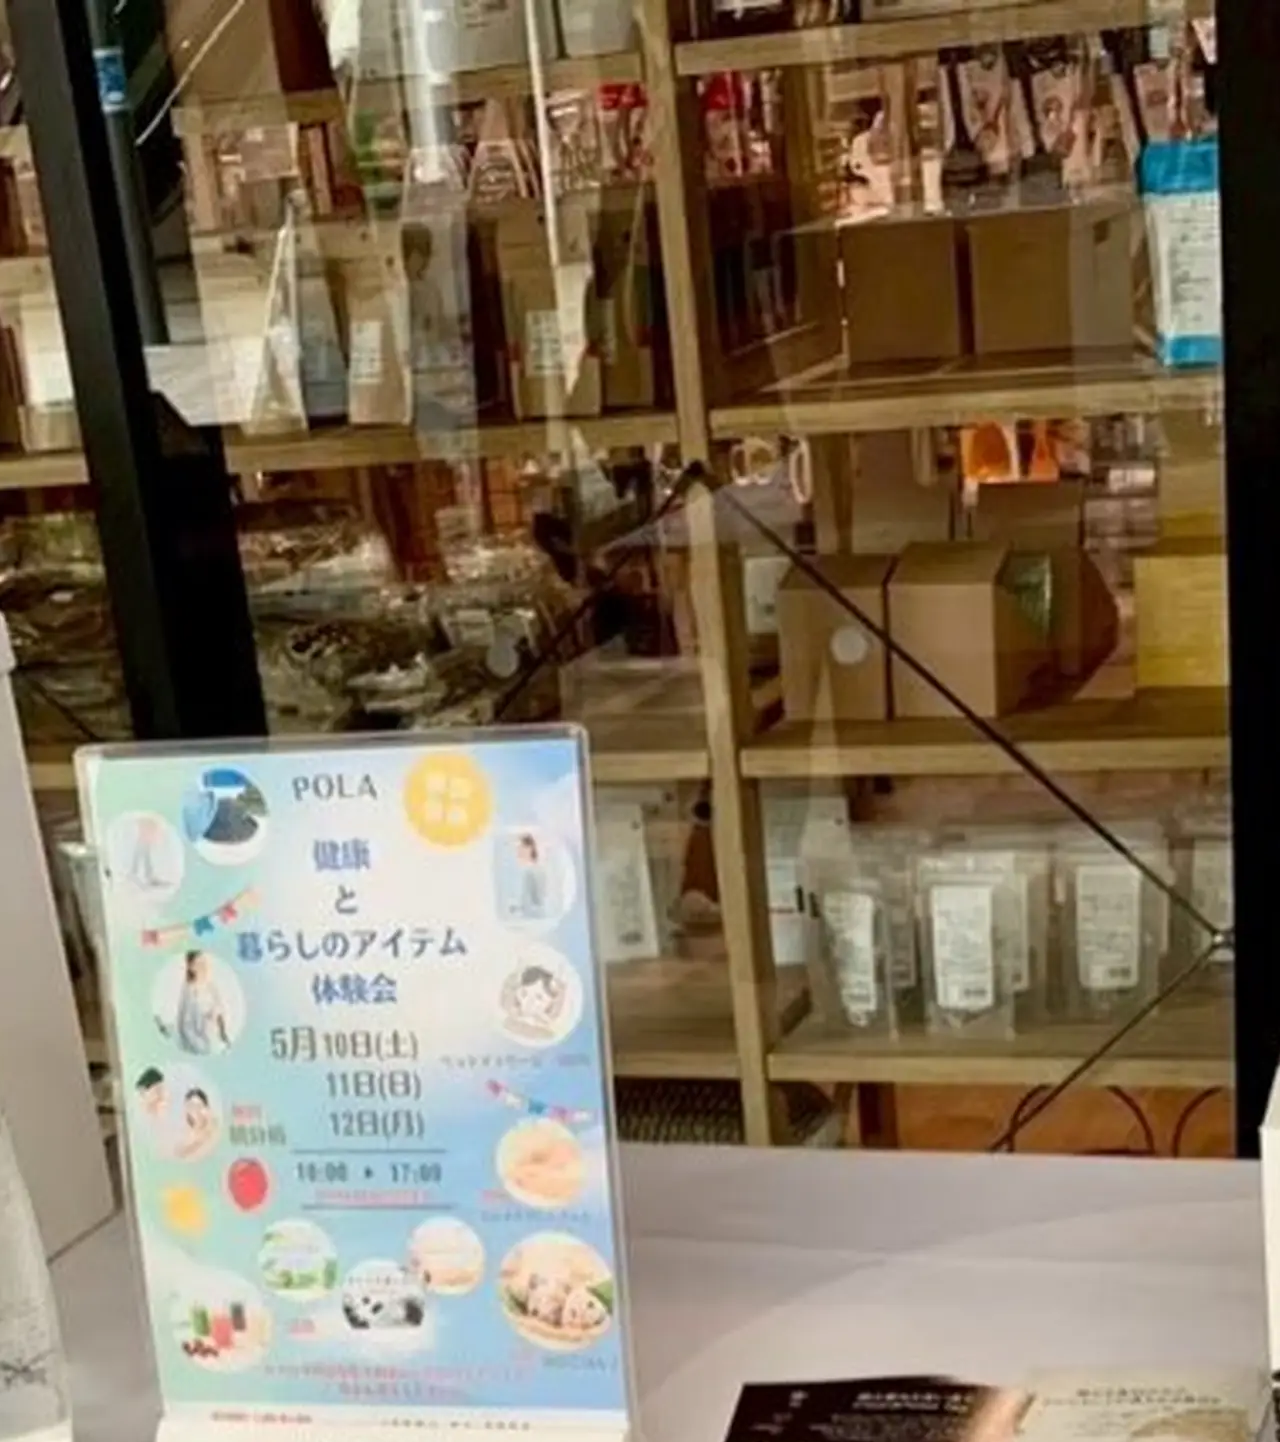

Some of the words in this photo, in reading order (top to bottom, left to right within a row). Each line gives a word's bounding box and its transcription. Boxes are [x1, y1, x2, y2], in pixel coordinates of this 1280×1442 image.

[292, 774, 378, 801] POLA
[313, 837, 371, 872] 健康
[335, 884, 358, 915] と
[237, 928, 468, 961] 暮らしのアイテム
[311, 971, 398, 1005] 体験会
[270, 1028, 420, 1062] 5月10日(土)
[326, 1069, 422, 1103] 11日(日)
[329, 1109, 426, 1140] 12日(月)
[296, 1160, 350, 1184] 10:00
[389, 1160, 444, 1184] 17:00
